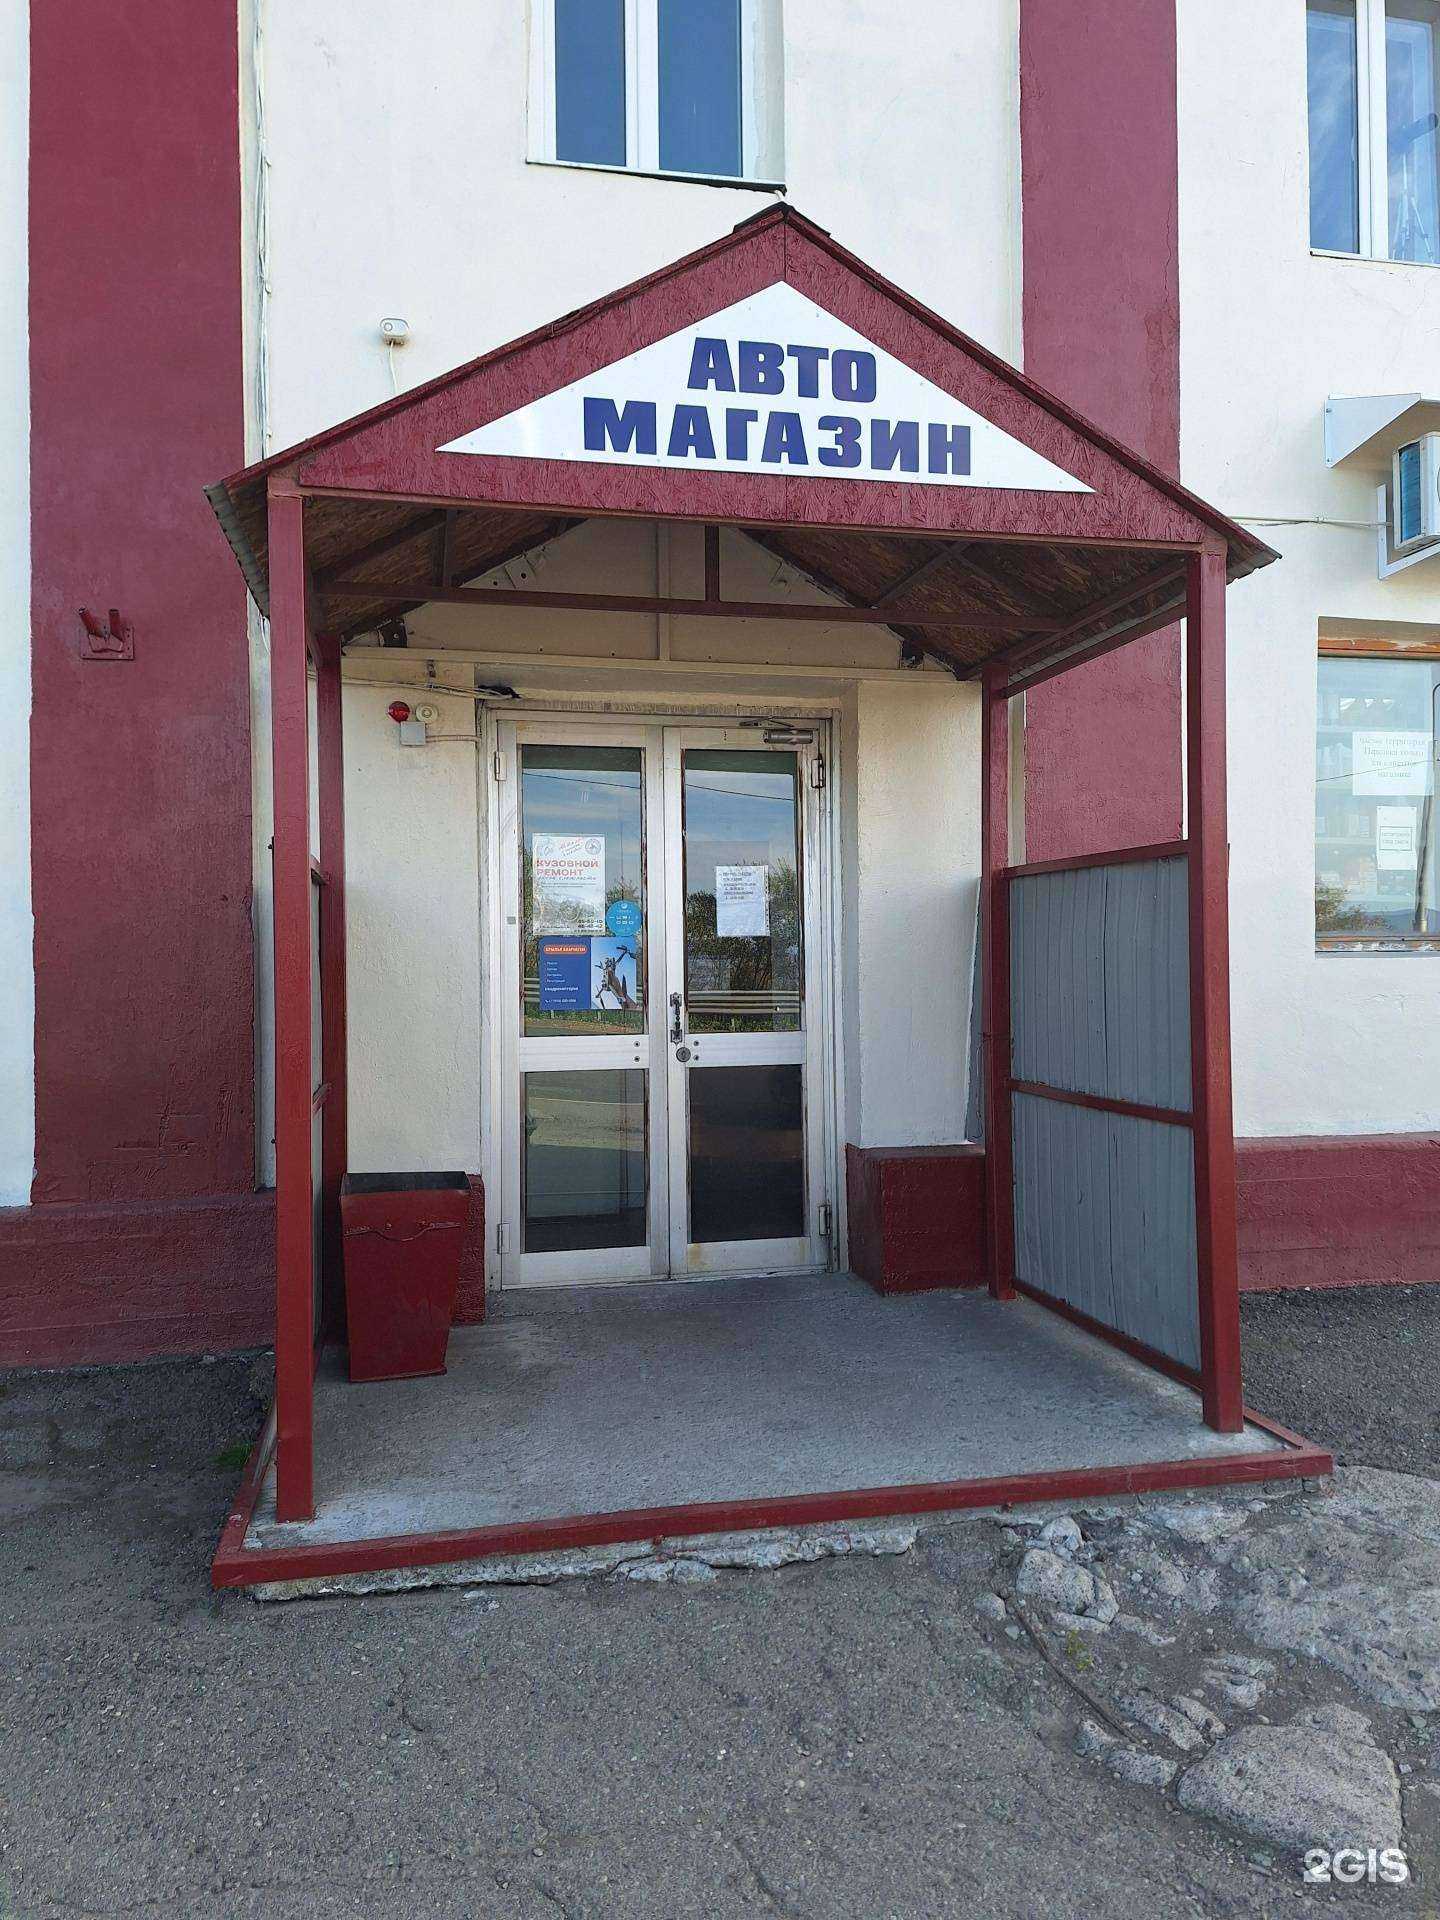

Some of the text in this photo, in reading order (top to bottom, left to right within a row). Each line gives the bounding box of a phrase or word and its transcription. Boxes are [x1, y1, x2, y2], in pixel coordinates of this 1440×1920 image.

[687, 337, 877, 403] АВТО
[583, 397, 971, 476] МАГАЗИН
[536, 857, 600, 868] КУЗОВНОЙ
[536, 868, 584, 877] РЕМОНТ
